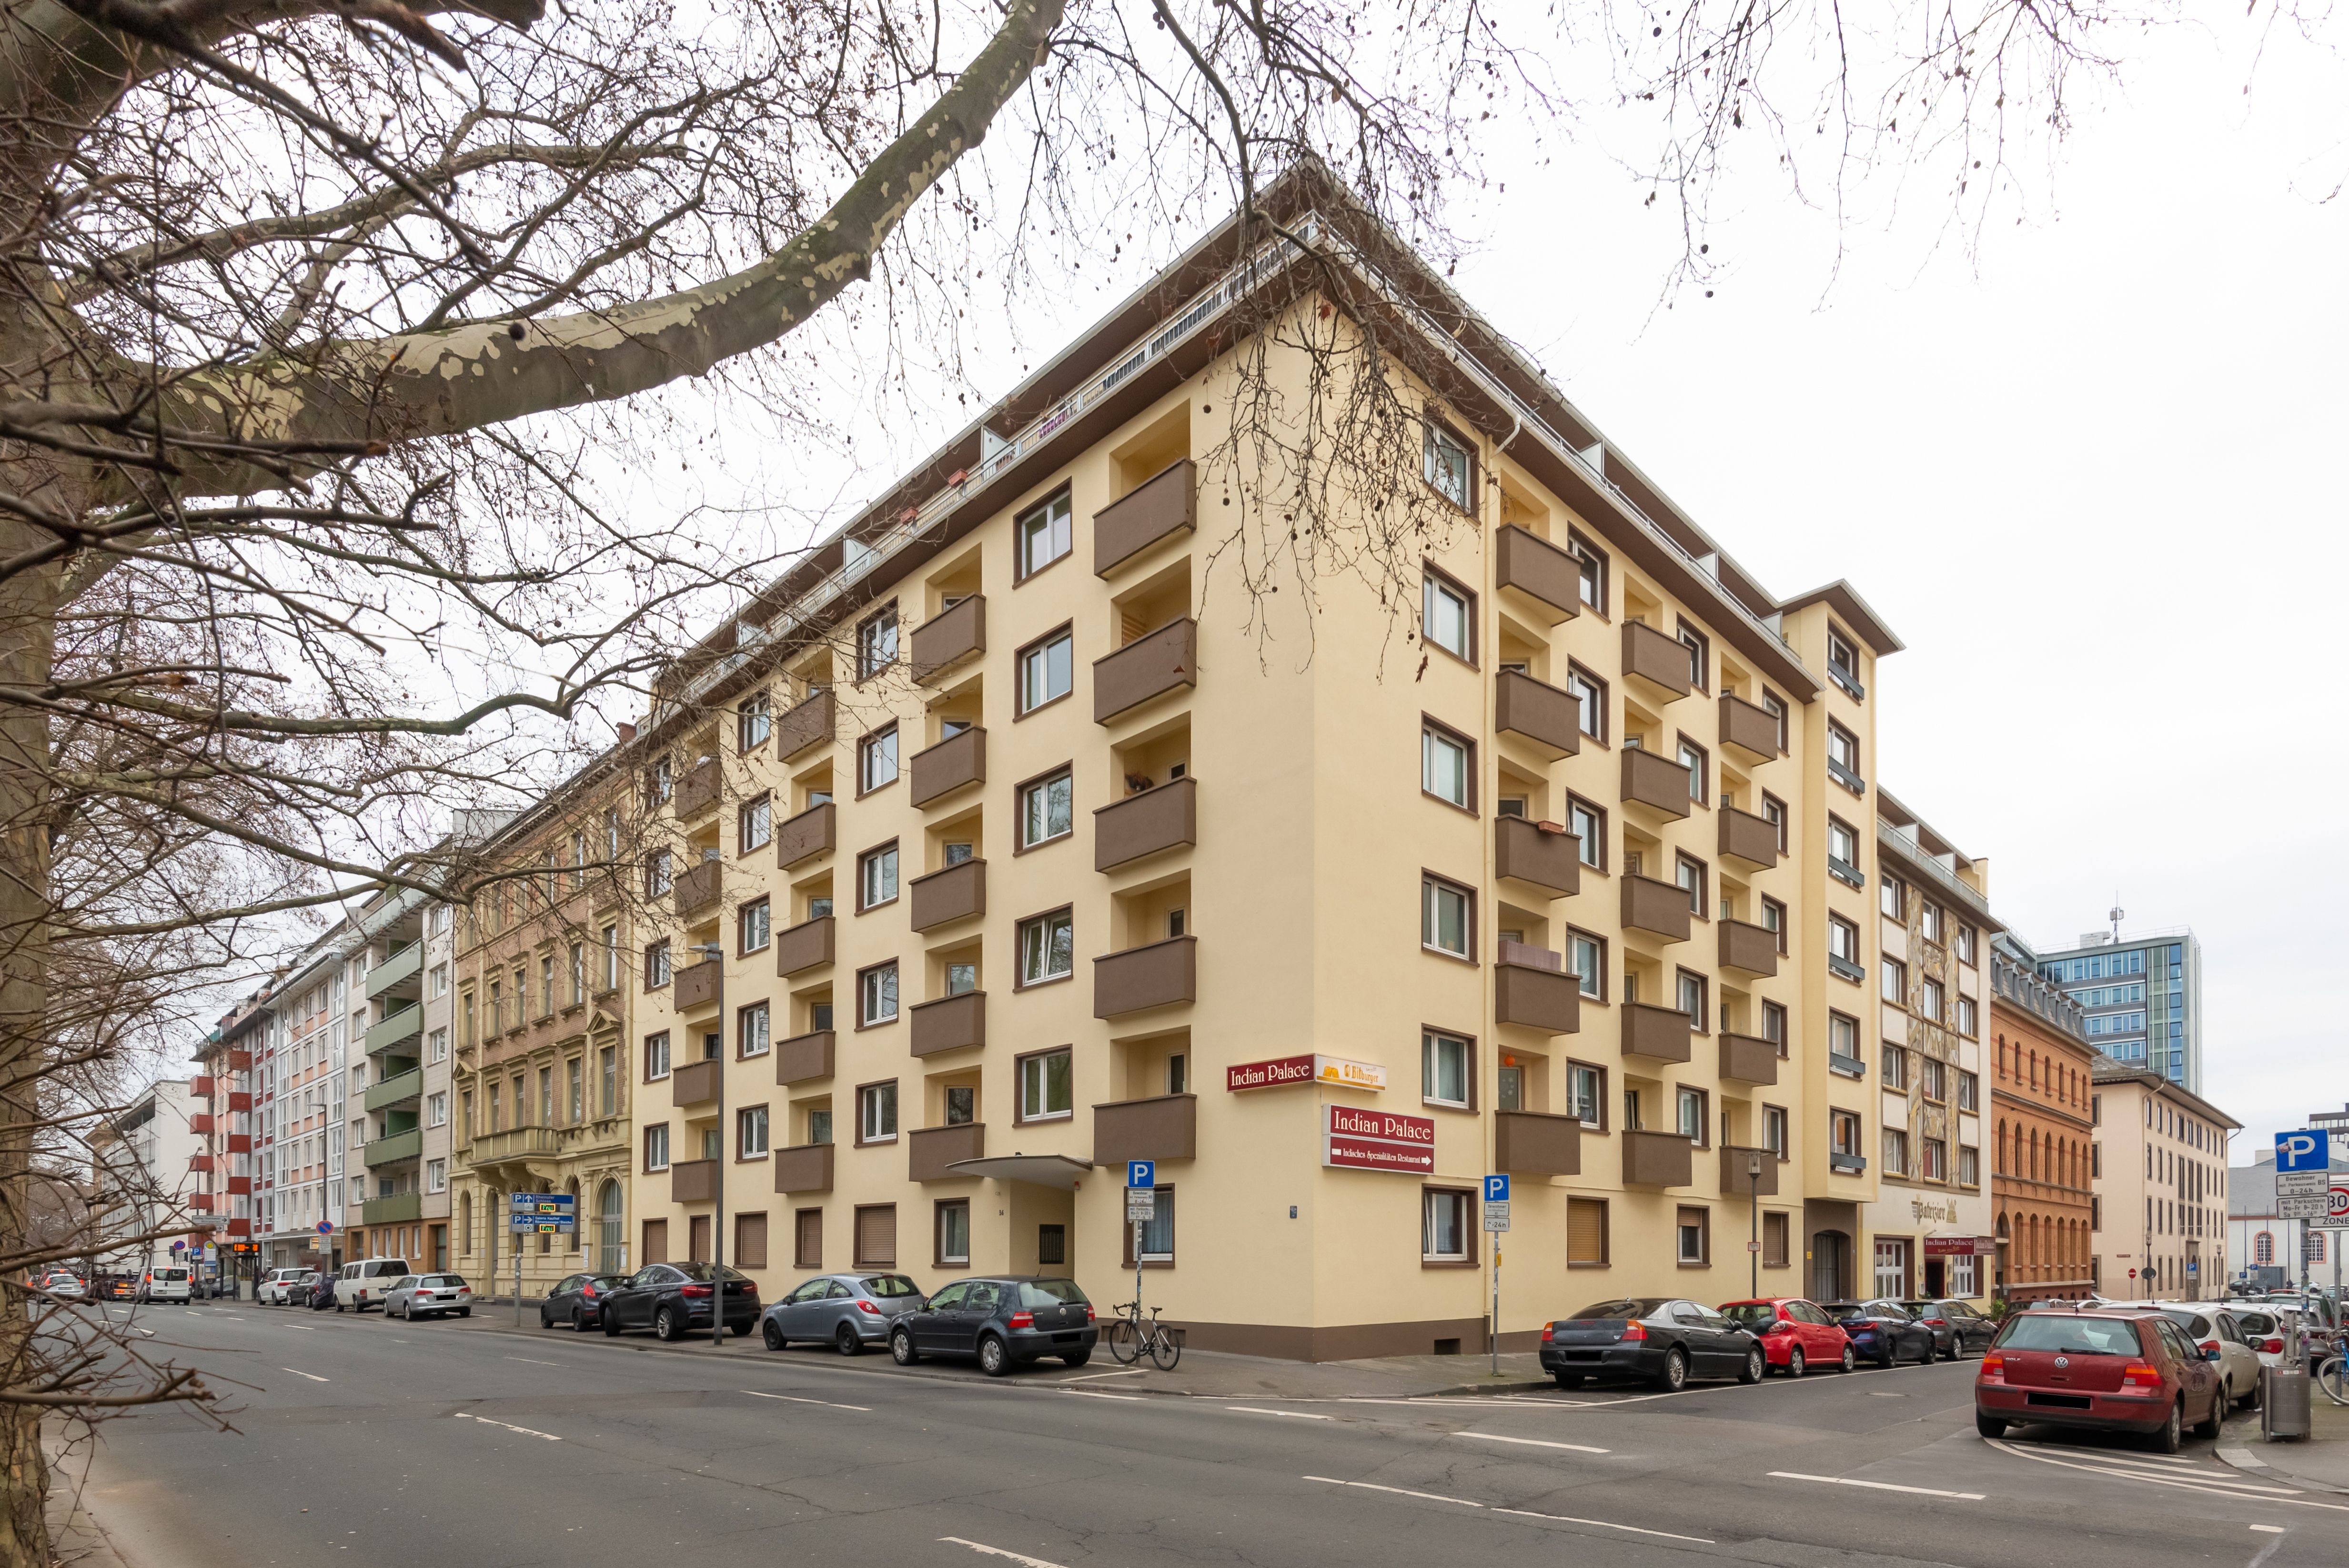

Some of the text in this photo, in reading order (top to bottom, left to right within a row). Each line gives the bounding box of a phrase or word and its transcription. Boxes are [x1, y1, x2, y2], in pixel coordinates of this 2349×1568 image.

[1230, 1062, 1310, 1086] Indian Palace
[1351, 1065, 1379, 1084] Bitburger
[1334, 1111, 1431, 1140] Indian Palace
[1343, 1148, 1421, 1164] Indisches Spezialitäten Restaurant
[2287, 1136, 2316, 1167] P
[1134, 1164, 1148, 1185] P
[1490, 1178, 1503, 1198] P
[1911, 1201, 1946, 1226] Patrizier
